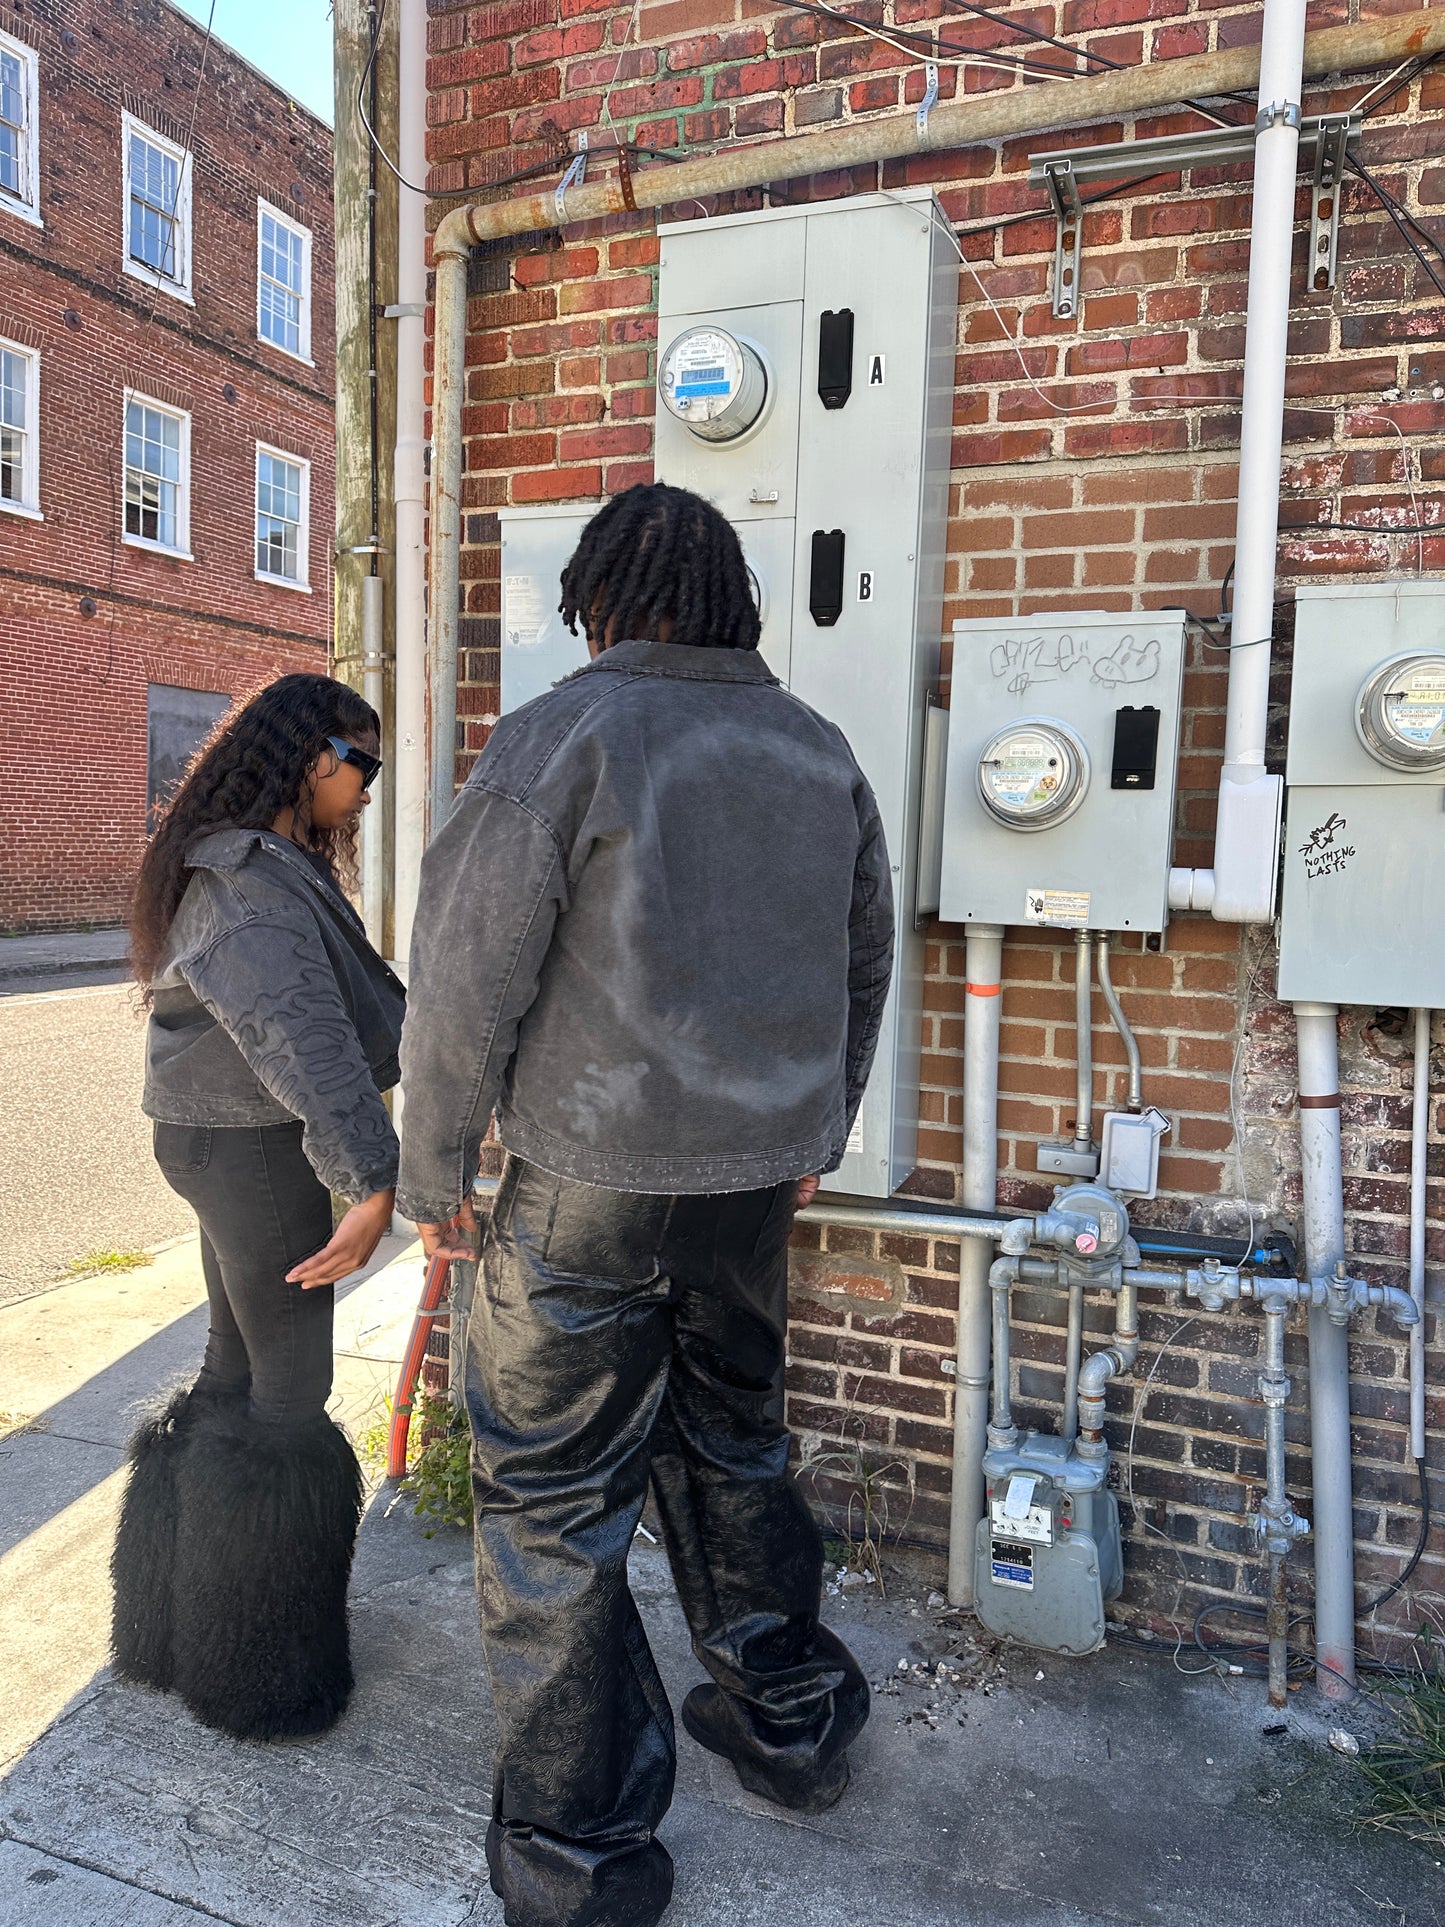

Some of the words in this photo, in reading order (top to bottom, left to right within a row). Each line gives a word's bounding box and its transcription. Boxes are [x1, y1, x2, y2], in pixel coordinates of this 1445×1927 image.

[870, 356, 883, 385] A
[859, 572, 871, 600] B
[1305, 846, 1356, 867] NOTHING
[1307, 860, 1346, 878] LASTS
